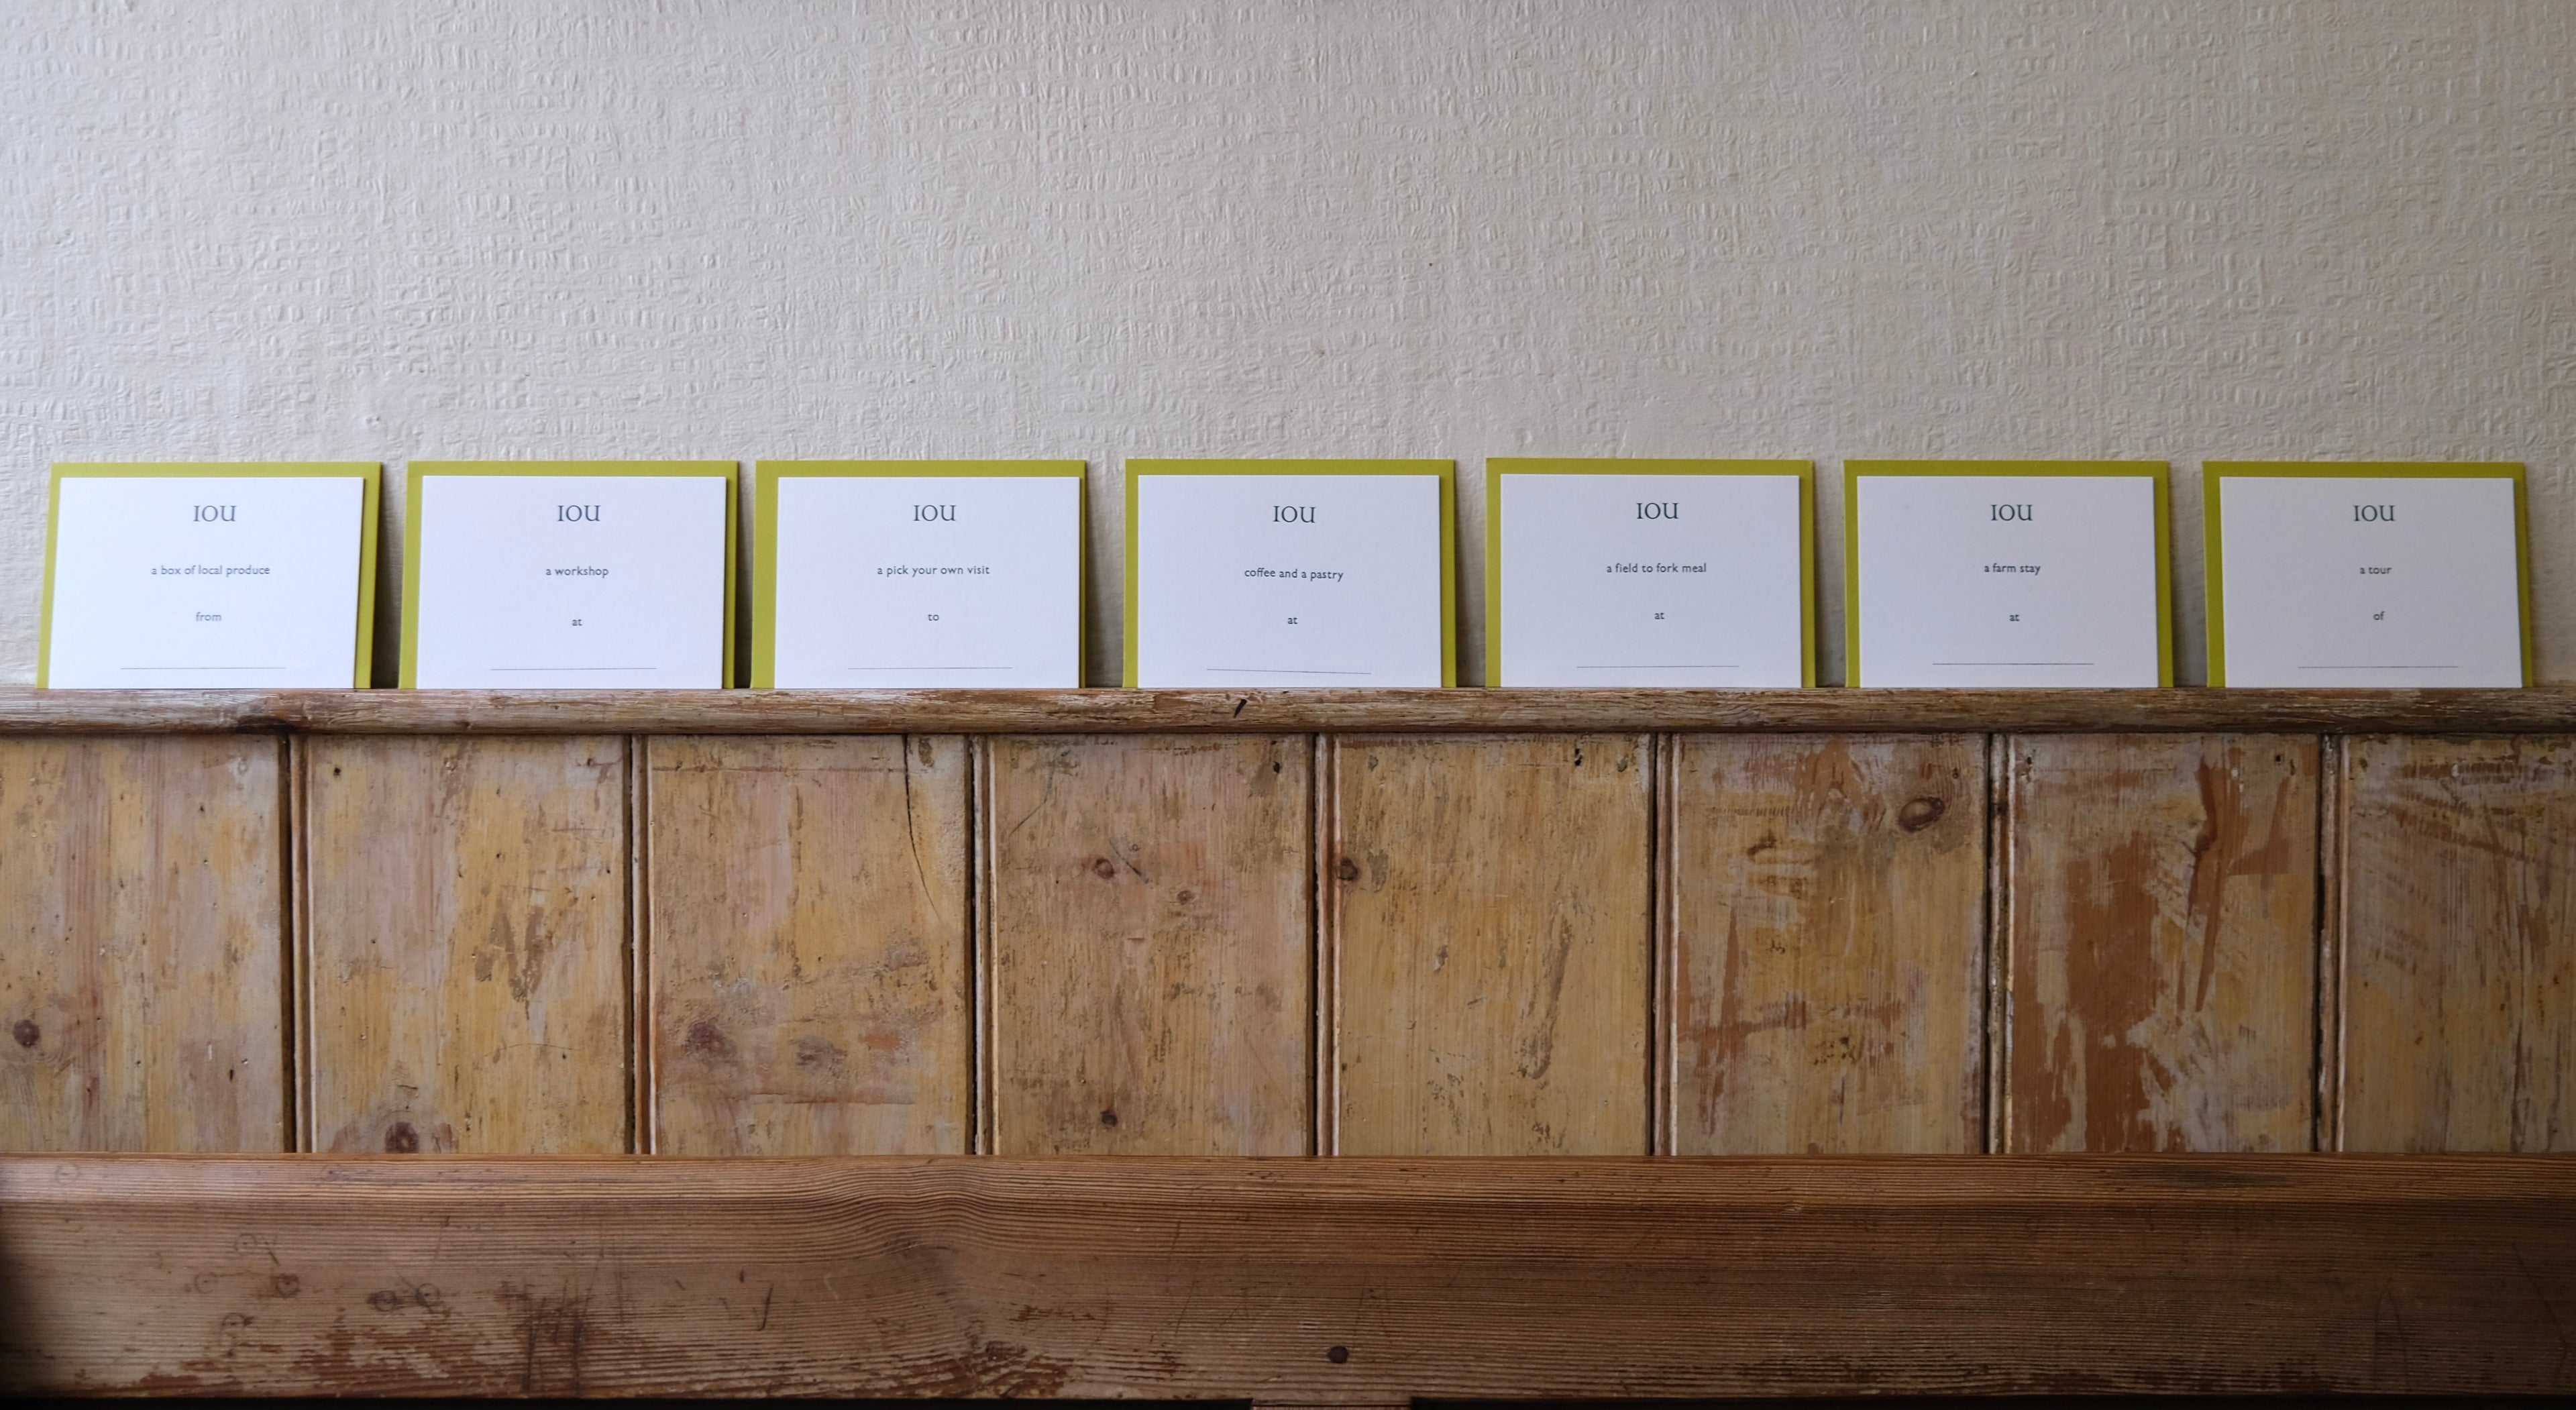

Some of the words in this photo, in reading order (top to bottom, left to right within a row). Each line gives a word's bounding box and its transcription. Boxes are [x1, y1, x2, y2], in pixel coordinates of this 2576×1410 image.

[193, 505, 237, 523] IOU
[556, 504, 602, 523] IOU
[913, 504, 957, 522] IOU
[1272, 505, 1317, 524] IOU
[1635, 502, 1679, 520] IOU
[1990, 504, 2033, 522] IOU
[2353, 504, 2396, 523] IOU
[160, 565, 182, 575] box
[184, 565, 197, 575] of
[198, 564, 223, 575] local
[225, 564, 271, 578] produce
[545, 568, 552, 576] a
[553, 565, 609, 579] workshop
[886, 564, 910, 578] pick
[912, 567, 938, 578] your
[940, 567, 964, 575] own
[967, 565, 990, 575] visit
[1244, 567, 1277, 578] coffee
[1279, 568, 1298, 579] and
[1301, 571, 1307, 579] a
[1309, 571, 1344, 583] pastry
[1606, 565, 1613, 574] a
[1615, 562, 1638, 574] field
[1641, 565, 1654, 573] to
[1656, 562, 1679, 573] fork
[1681, 562, 1707, 574] meal
[1984, 565, 1990, 573] a
[1992, 562, 2017, 573] farm
[2019, 565, 2041, 576] stay
[2359, 567, 2366, 575] a
[2367, 567, 2393, 575] tour
[195, 611, 222, 622] from
[572, 618, 583, 627] at
[927, 613, 940, 622] to
[1287, 616, 1298, 625] at
[1654, 612, 1666, 620] at
[2008, 614, 2021, 622] at
[2373, 610, 2385, 621] of
